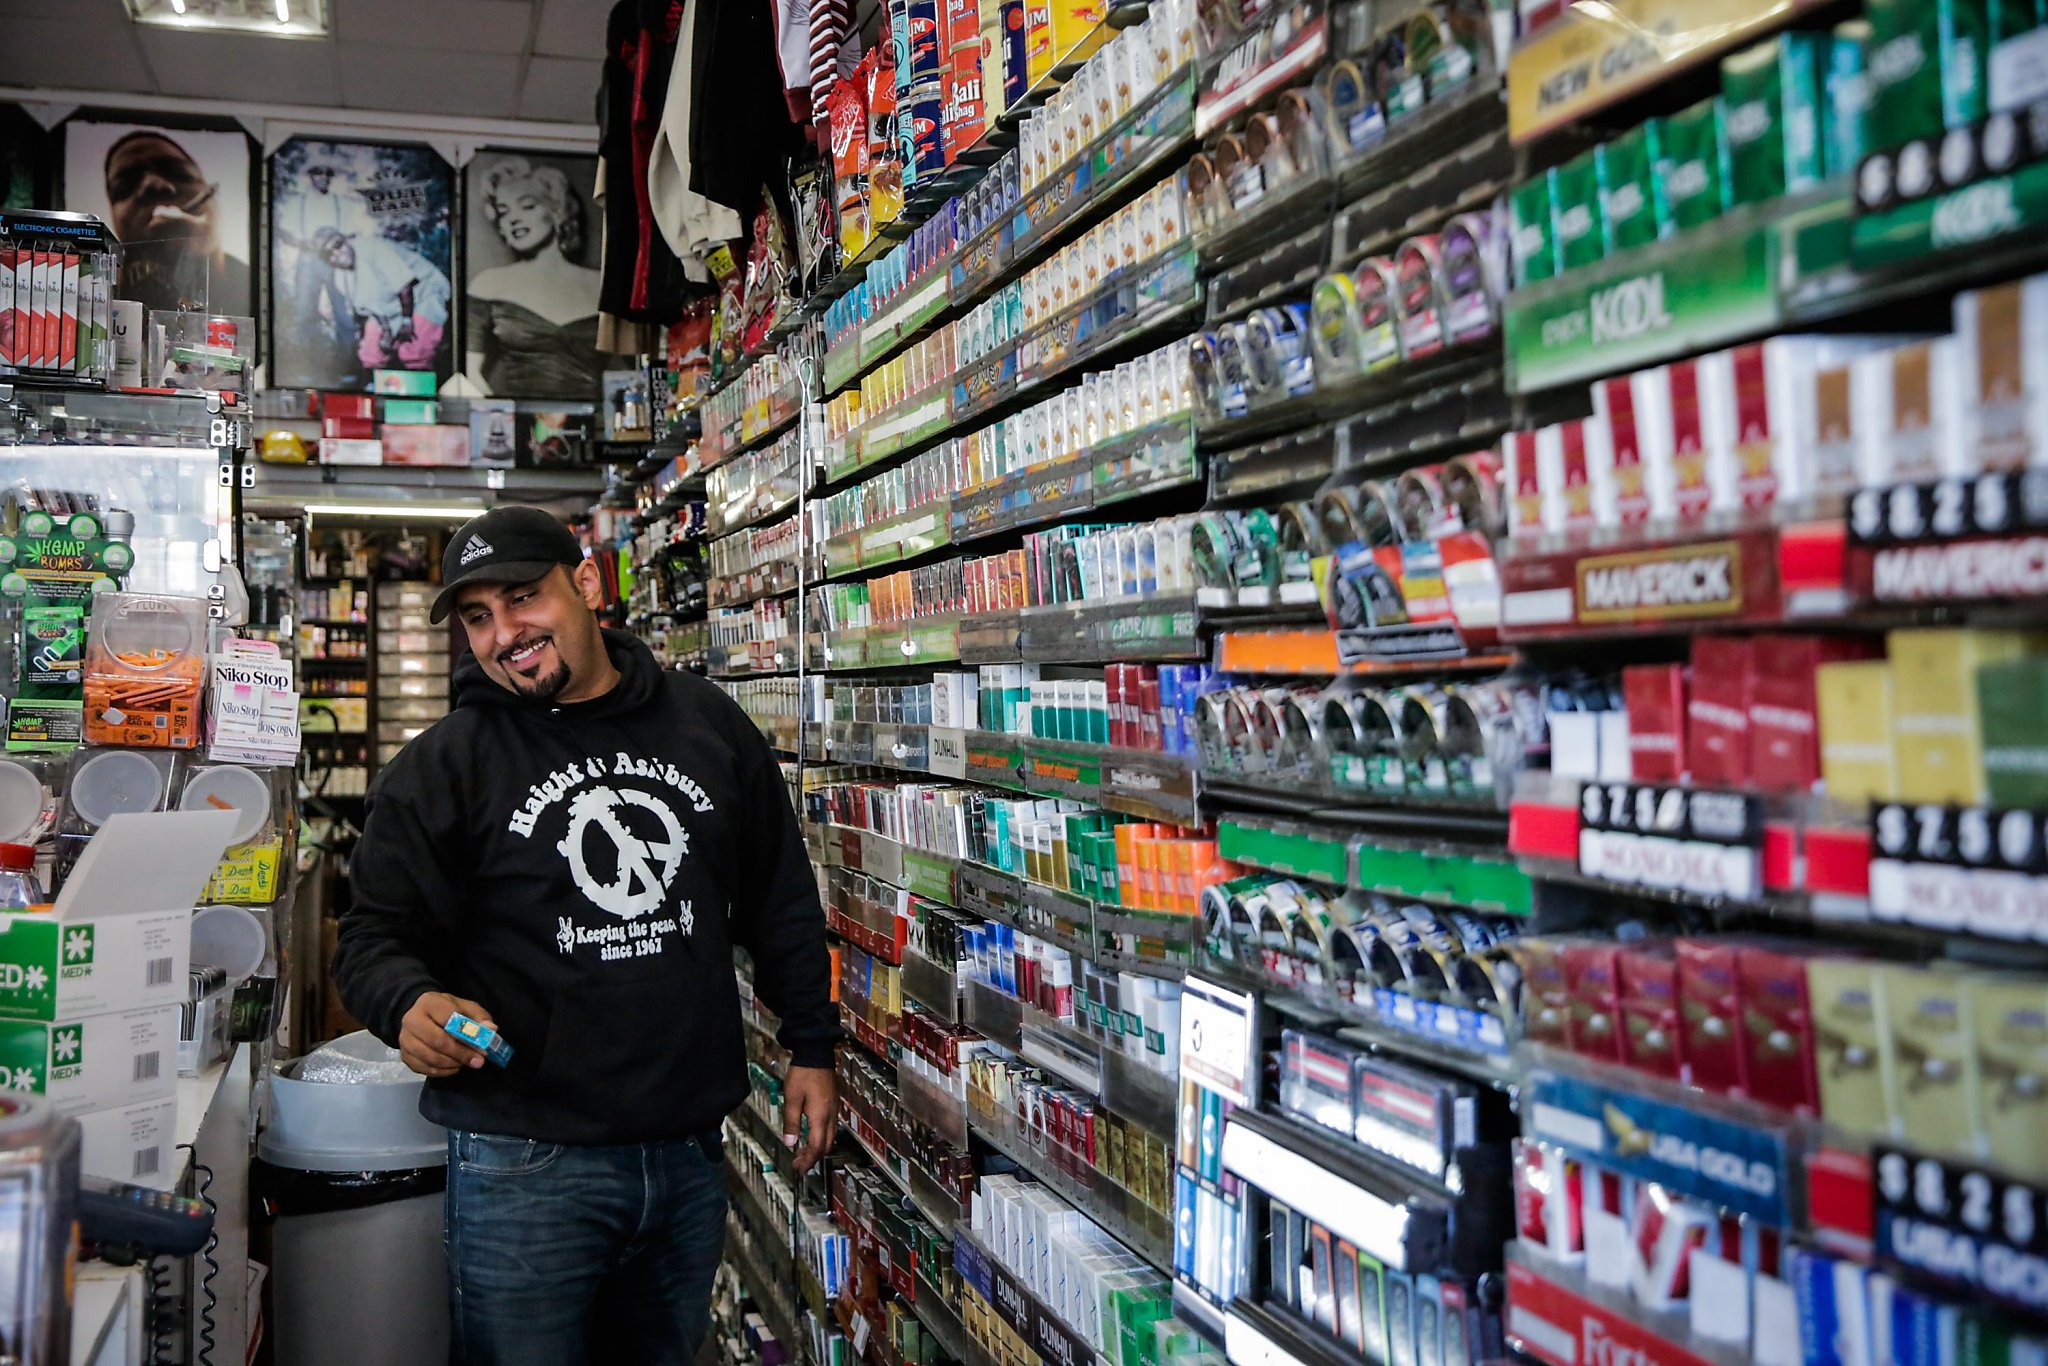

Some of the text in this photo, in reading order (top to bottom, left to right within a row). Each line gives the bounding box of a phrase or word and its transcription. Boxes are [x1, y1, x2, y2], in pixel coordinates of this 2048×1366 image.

[14, 223, 55, 234] ELECTRONIC
[55, 226, 97, 236] CIGARETTES
[1591, 272, 1672, 344] KOOL
[41, 555, 82, 570] BOMBS
[461, 546, 494, 565] adidas
[1873, 536, 2048, 598] MAVERIC
[1585, 555, 1731, 608] MAVERICK
[216, 667, 289, 691] Niko Stop
[221, 702, 259, 719] Niko Stop
[934, 739, 959, 759] DUNHILL
[508, 762, 585, 838] Haight
[613, 752, 714, 812] Ashbury
[576, 924, 627, 945] Keeping
[627, 921, 648, 938] the
[600, 937, 662, 960] since 1967
[62, 967, 83, 979] MED
[51, 1068, 73, 1081] MED
[1648, 1136, 1776, 1199] USA GOLD
[1890, 1215, 2048, 1306] USA GO
[997, 1275, 1028, 1323] DUNHILL
[1039, 1316, 1075, 1366] DUNHILL
